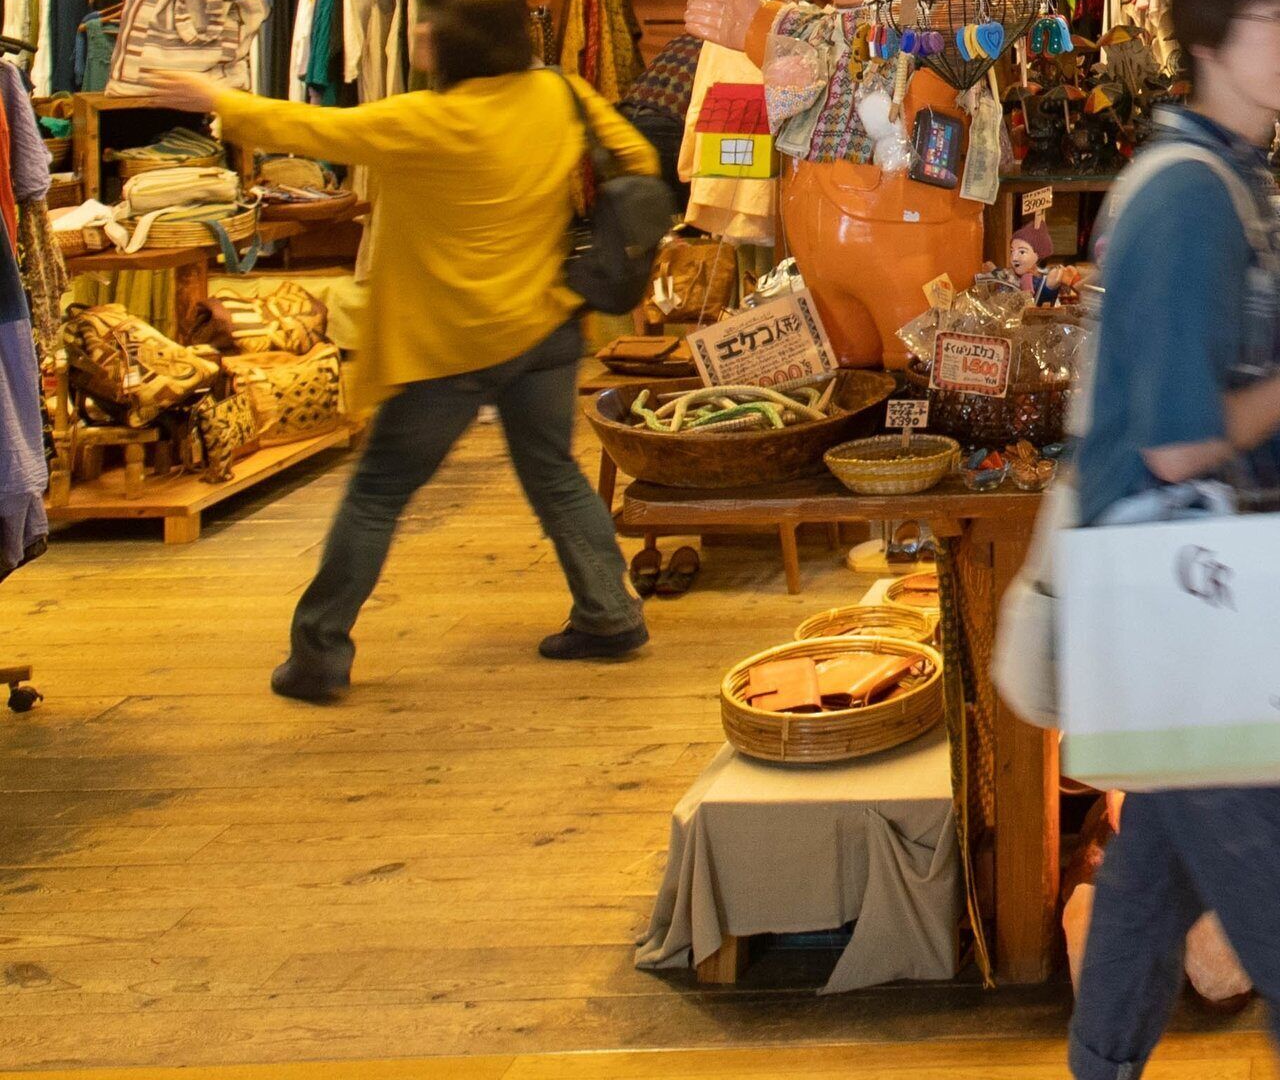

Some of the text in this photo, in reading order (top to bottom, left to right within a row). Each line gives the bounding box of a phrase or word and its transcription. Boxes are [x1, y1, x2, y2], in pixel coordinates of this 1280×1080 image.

[716, 314, 801, 361] エケコ人形
